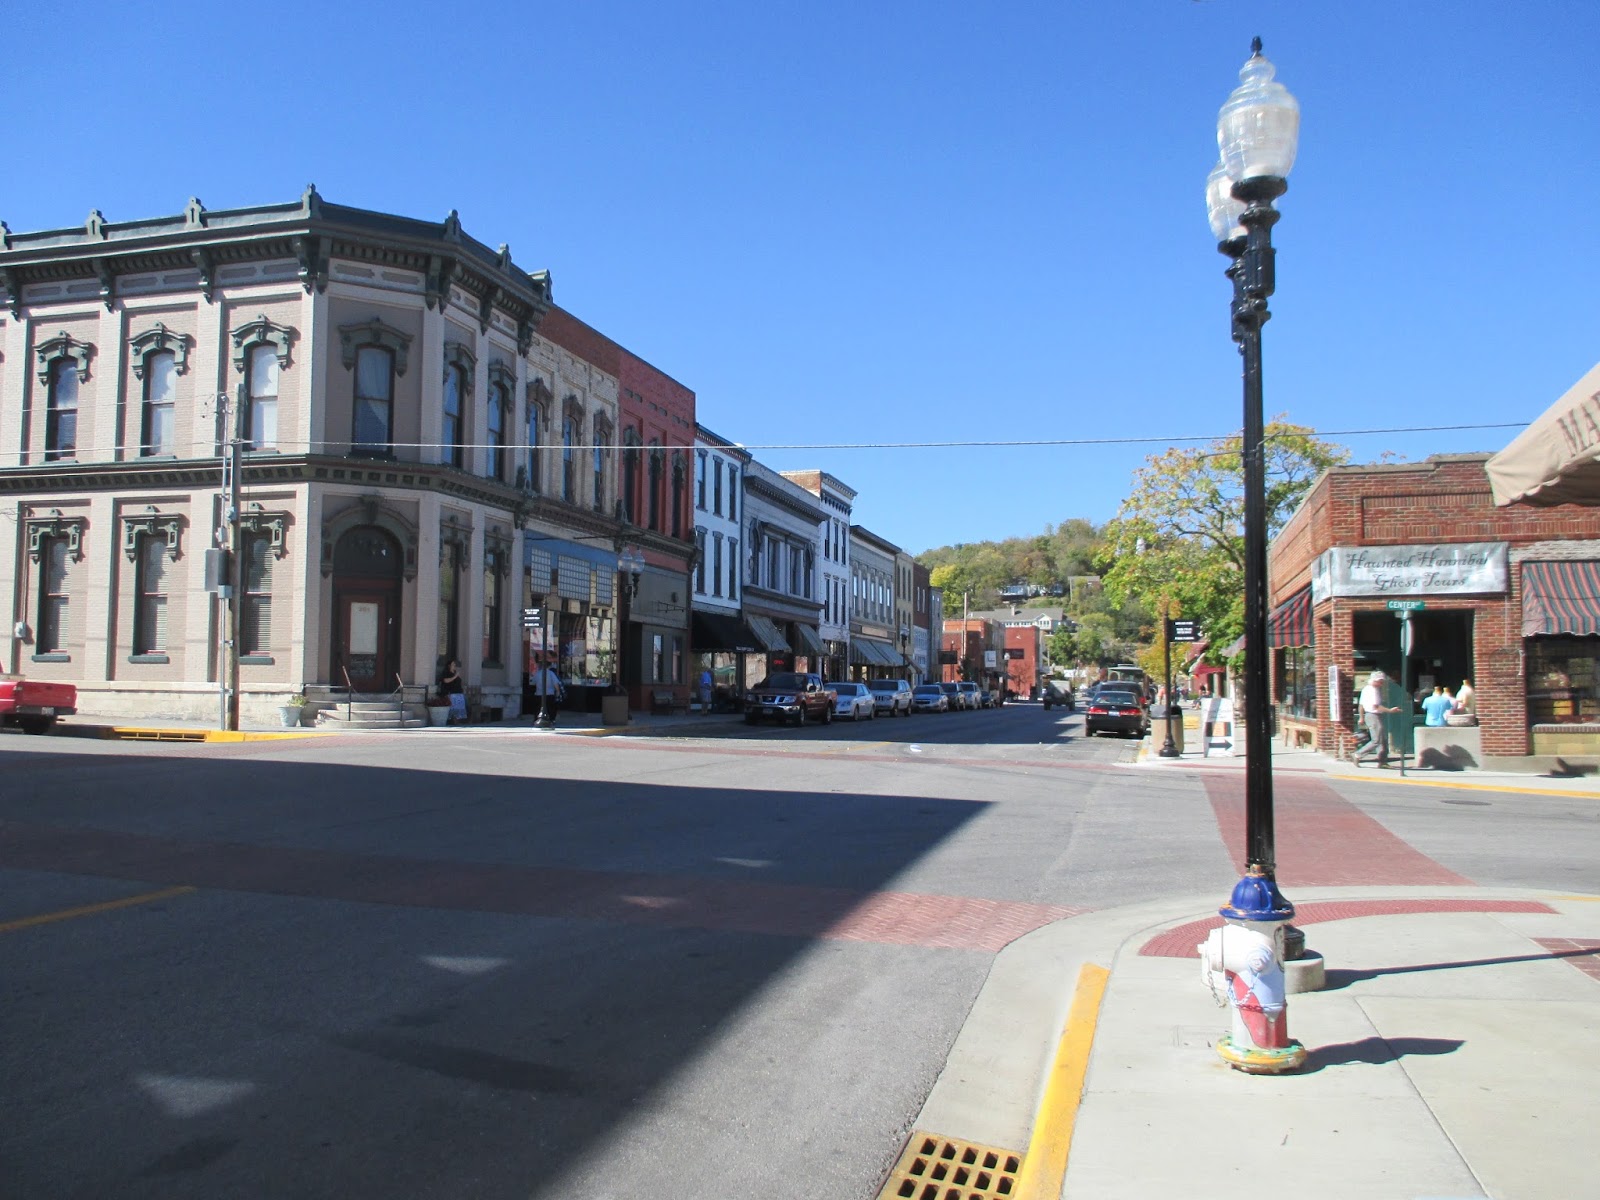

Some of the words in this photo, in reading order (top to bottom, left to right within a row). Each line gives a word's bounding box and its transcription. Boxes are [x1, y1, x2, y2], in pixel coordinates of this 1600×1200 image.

[1556, 389, 1600, 458] MA
[1346, 551, 1415, 569] Haunted
[1417, 548, 1489, 567] Hannibal
[1373, 572, 1418, 591] Ghost
[1423, 571, 1468, 587] Tours
[1388, 600, 1415, 609] CENTER
